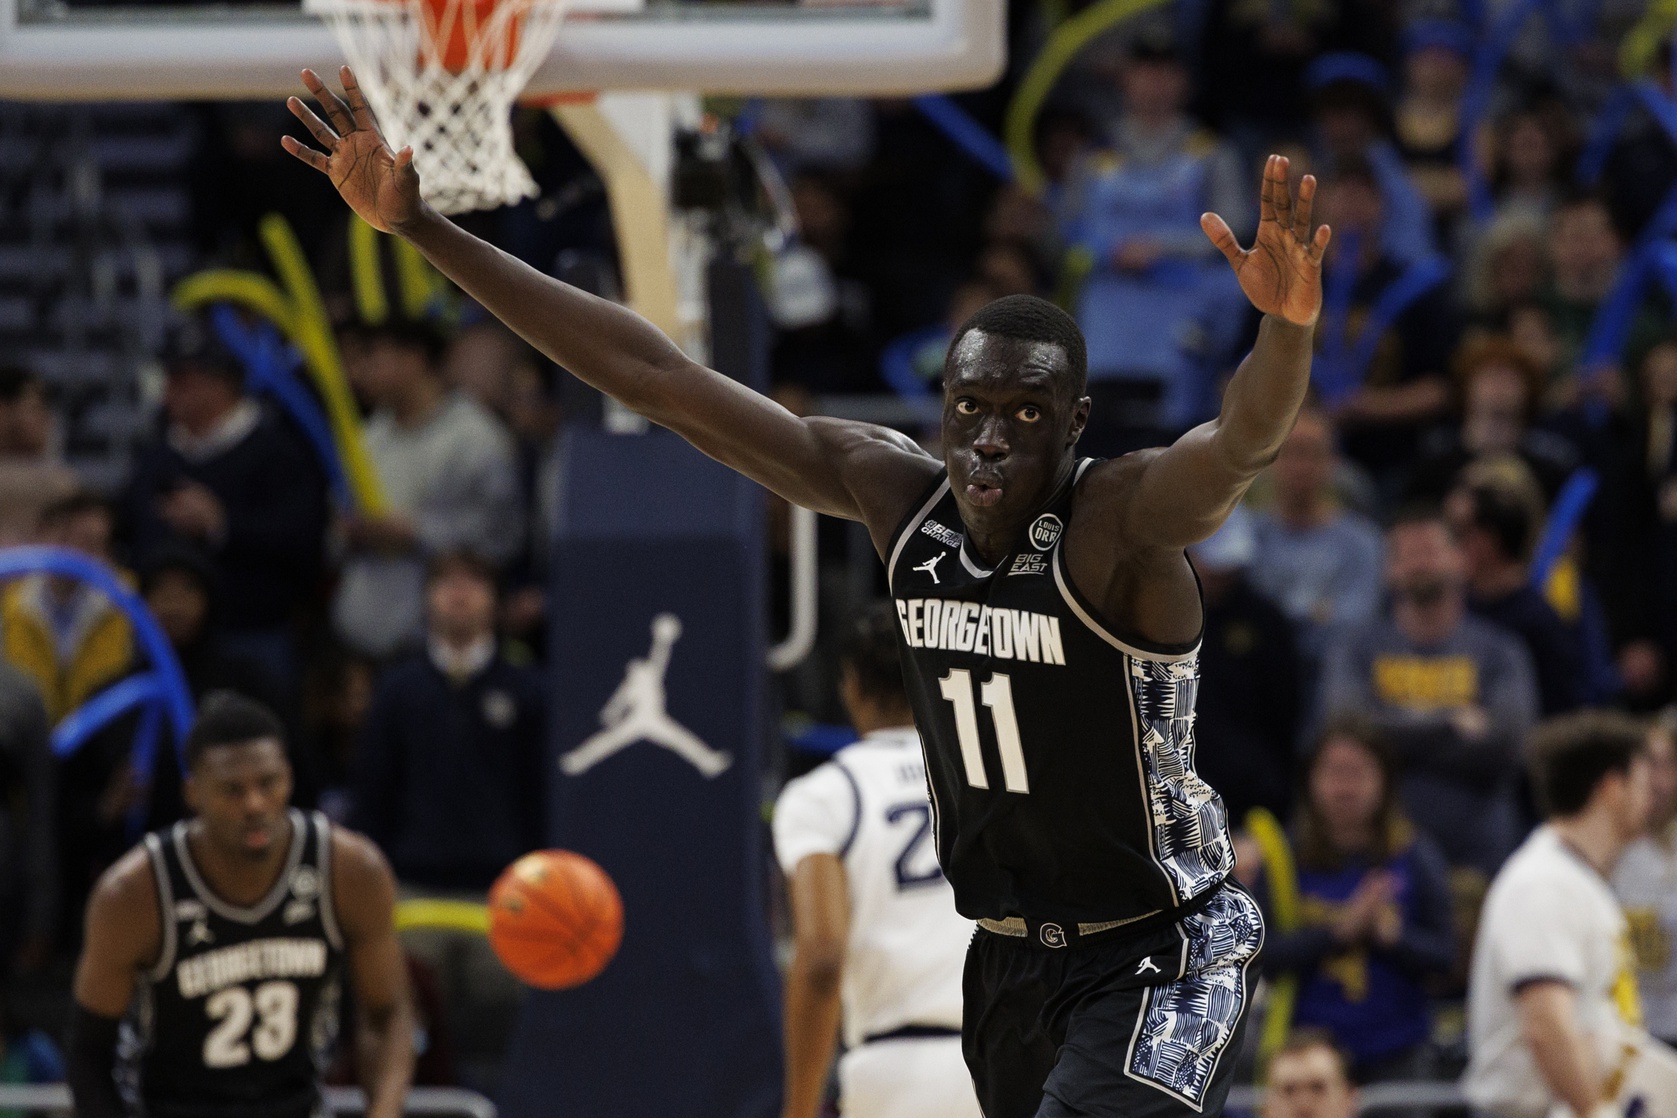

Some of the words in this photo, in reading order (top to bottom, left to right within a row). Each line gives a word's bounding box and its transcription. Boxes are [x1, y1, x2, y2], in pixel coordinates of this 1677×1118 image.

[1038, 520, 1060, 531] LOUIS
[921, 527, 960, 548] CHANGE
[1034, 528, 1057, 542] ORR
[1010, 562, 1047, 572] EAST
[1015, 554, 1043, 563] BIG
[896, 598, 1066, 666] GEORGETOWN
[938, 668, 1030, 794] 11
[203, 981, 299, 1068] 23
